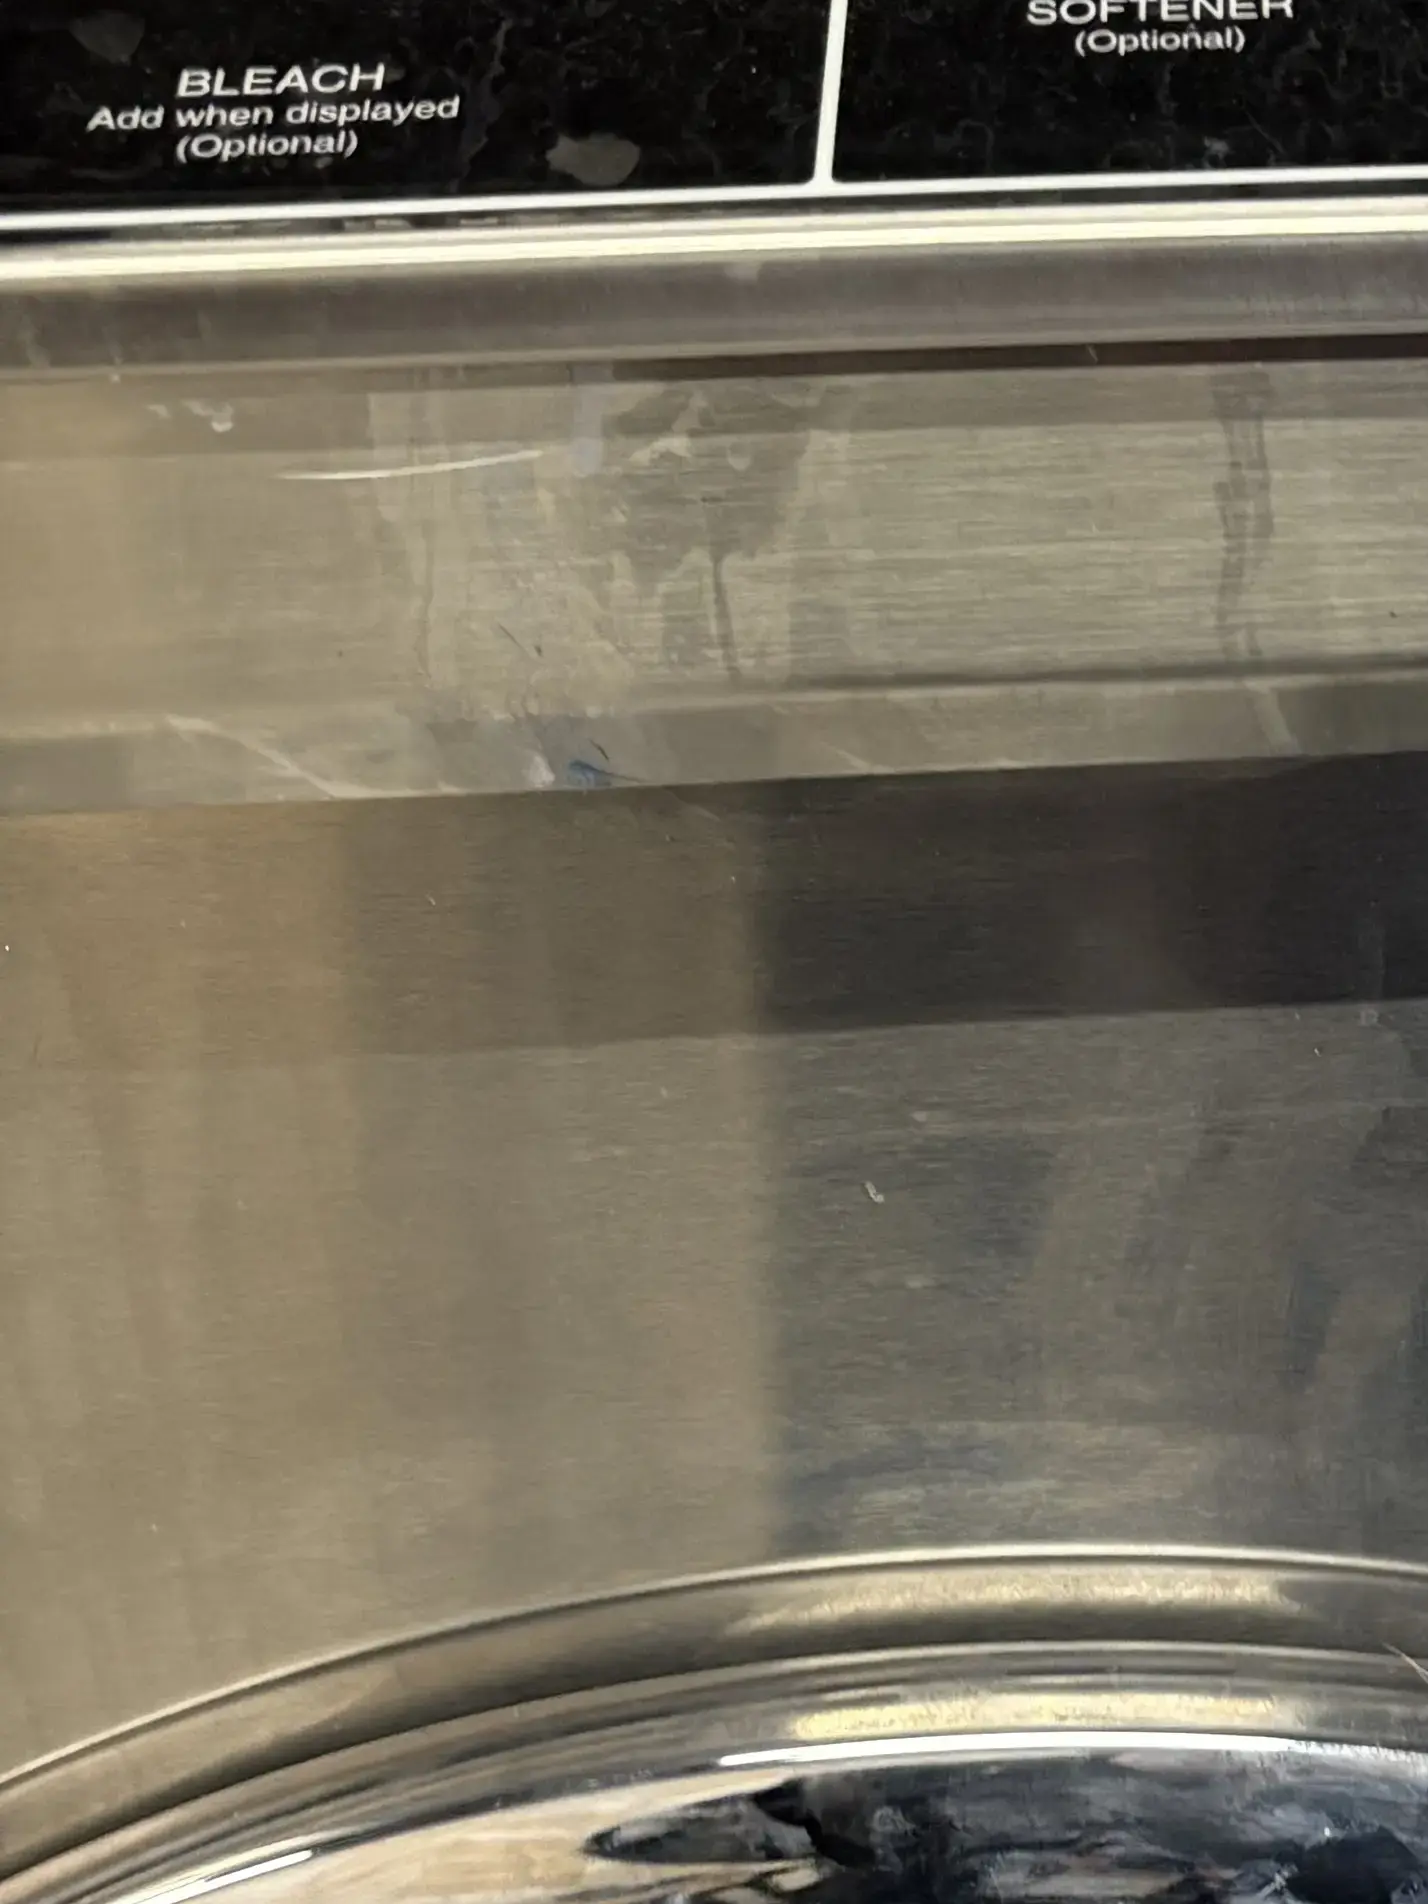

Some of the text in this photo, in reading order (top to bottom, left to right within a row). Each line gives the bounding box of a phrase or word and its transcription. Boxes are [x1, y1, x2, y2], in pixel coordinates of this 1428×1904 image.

[1074, 26, 1246, 57] (Optional)
[177, 64, 386, 97] BLEACH
[88, 97, 461, 131] Add when displayed
[175, 131, 359, 163] (Optional)
